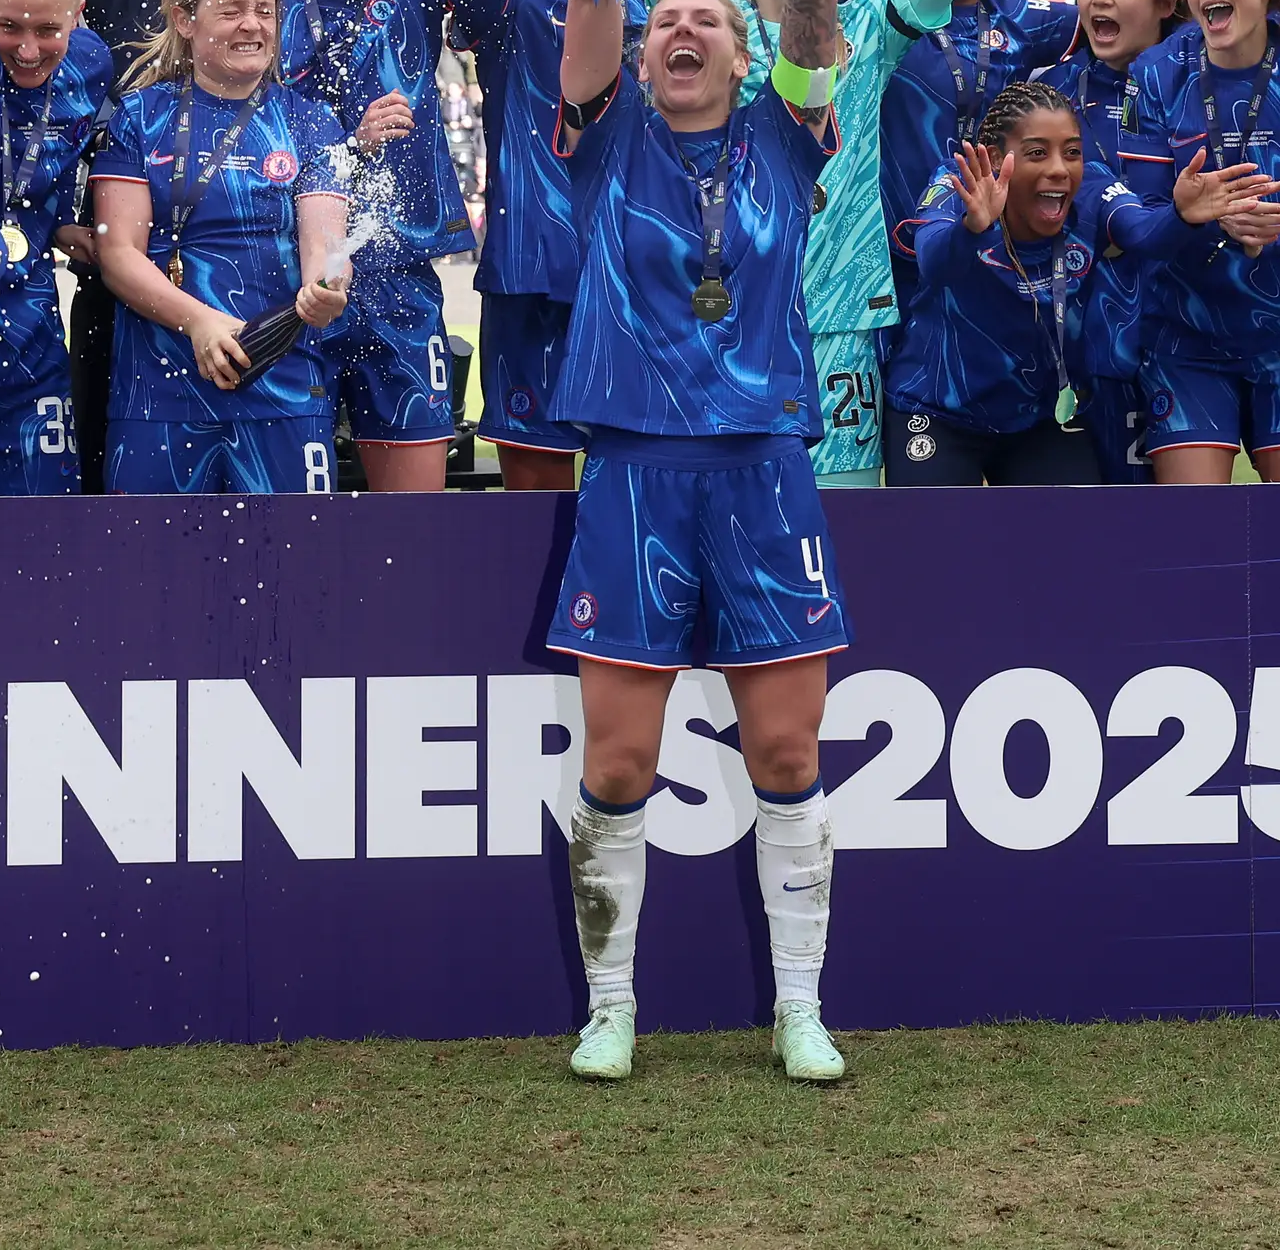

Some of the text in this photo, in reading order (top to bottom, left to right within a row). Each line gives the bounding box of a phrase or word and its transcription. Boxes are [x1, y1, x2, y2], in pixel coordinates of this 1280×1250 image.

[428, 335, 448, 391] 6
[826, 371, 879, 429] 24
[304, 442, 331, 493] 8
[801, 536, 830, 599] 4
